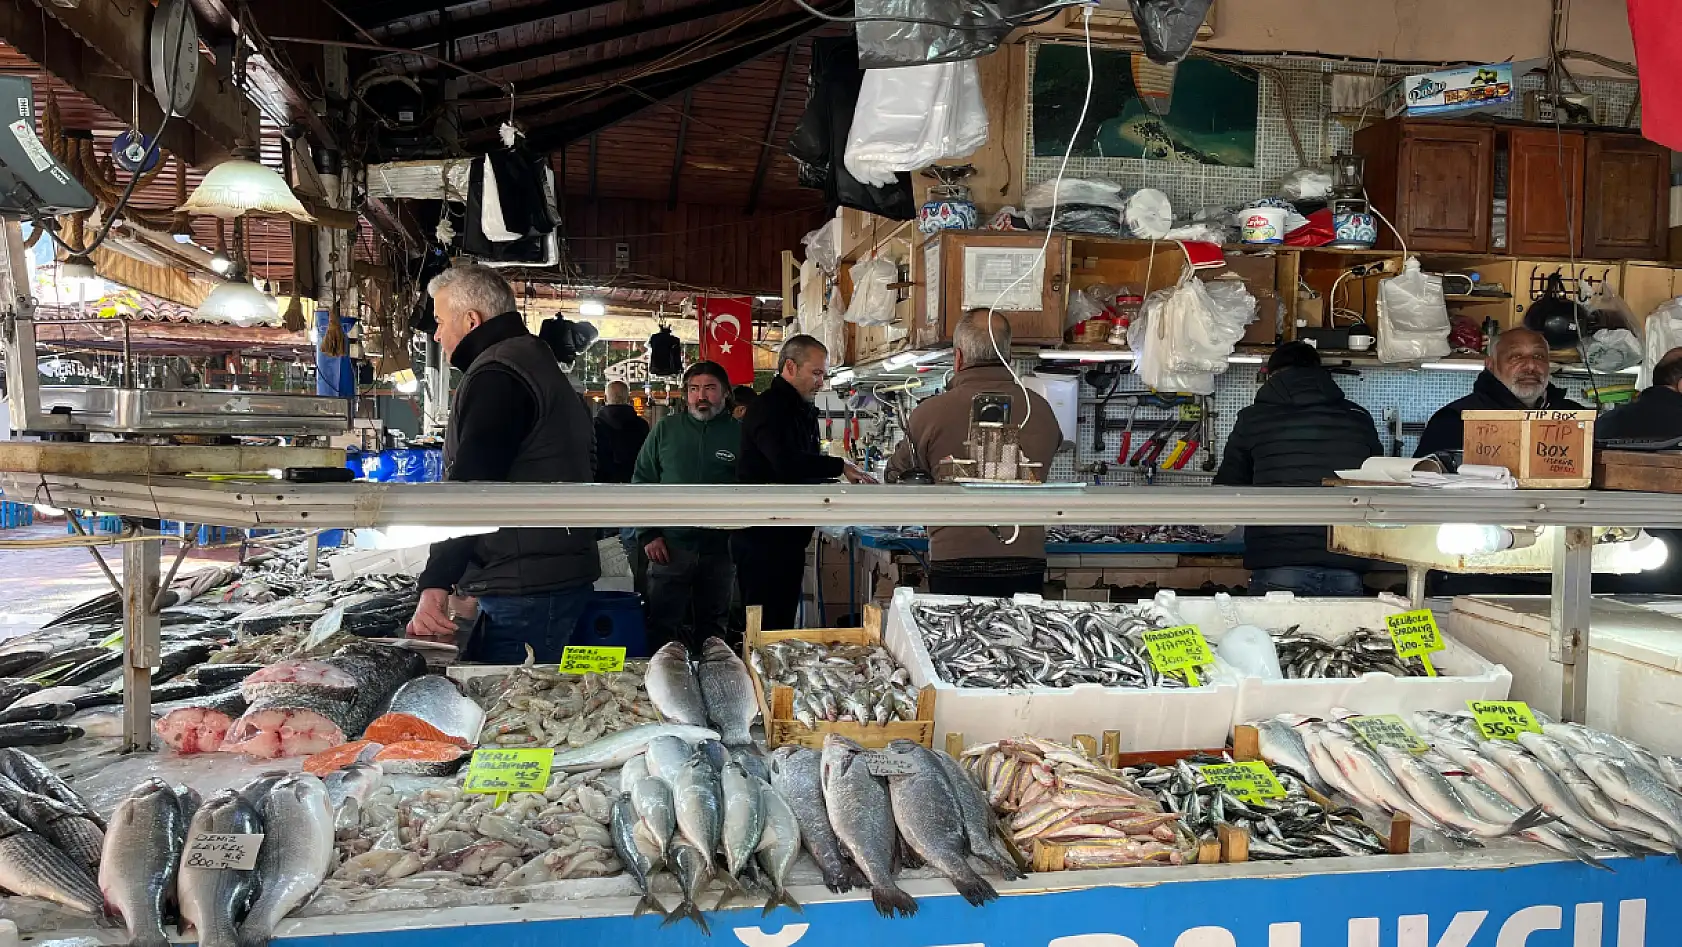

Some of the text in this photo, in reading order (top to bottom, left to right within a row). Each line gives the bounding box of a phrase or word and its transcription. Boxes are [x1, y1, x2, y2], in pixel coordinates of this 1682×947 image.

[1476, 442, 1502, 458] BOX
[1536, 442, 1570, 457] BOX
[1482, 722, 1515, 736] 550
